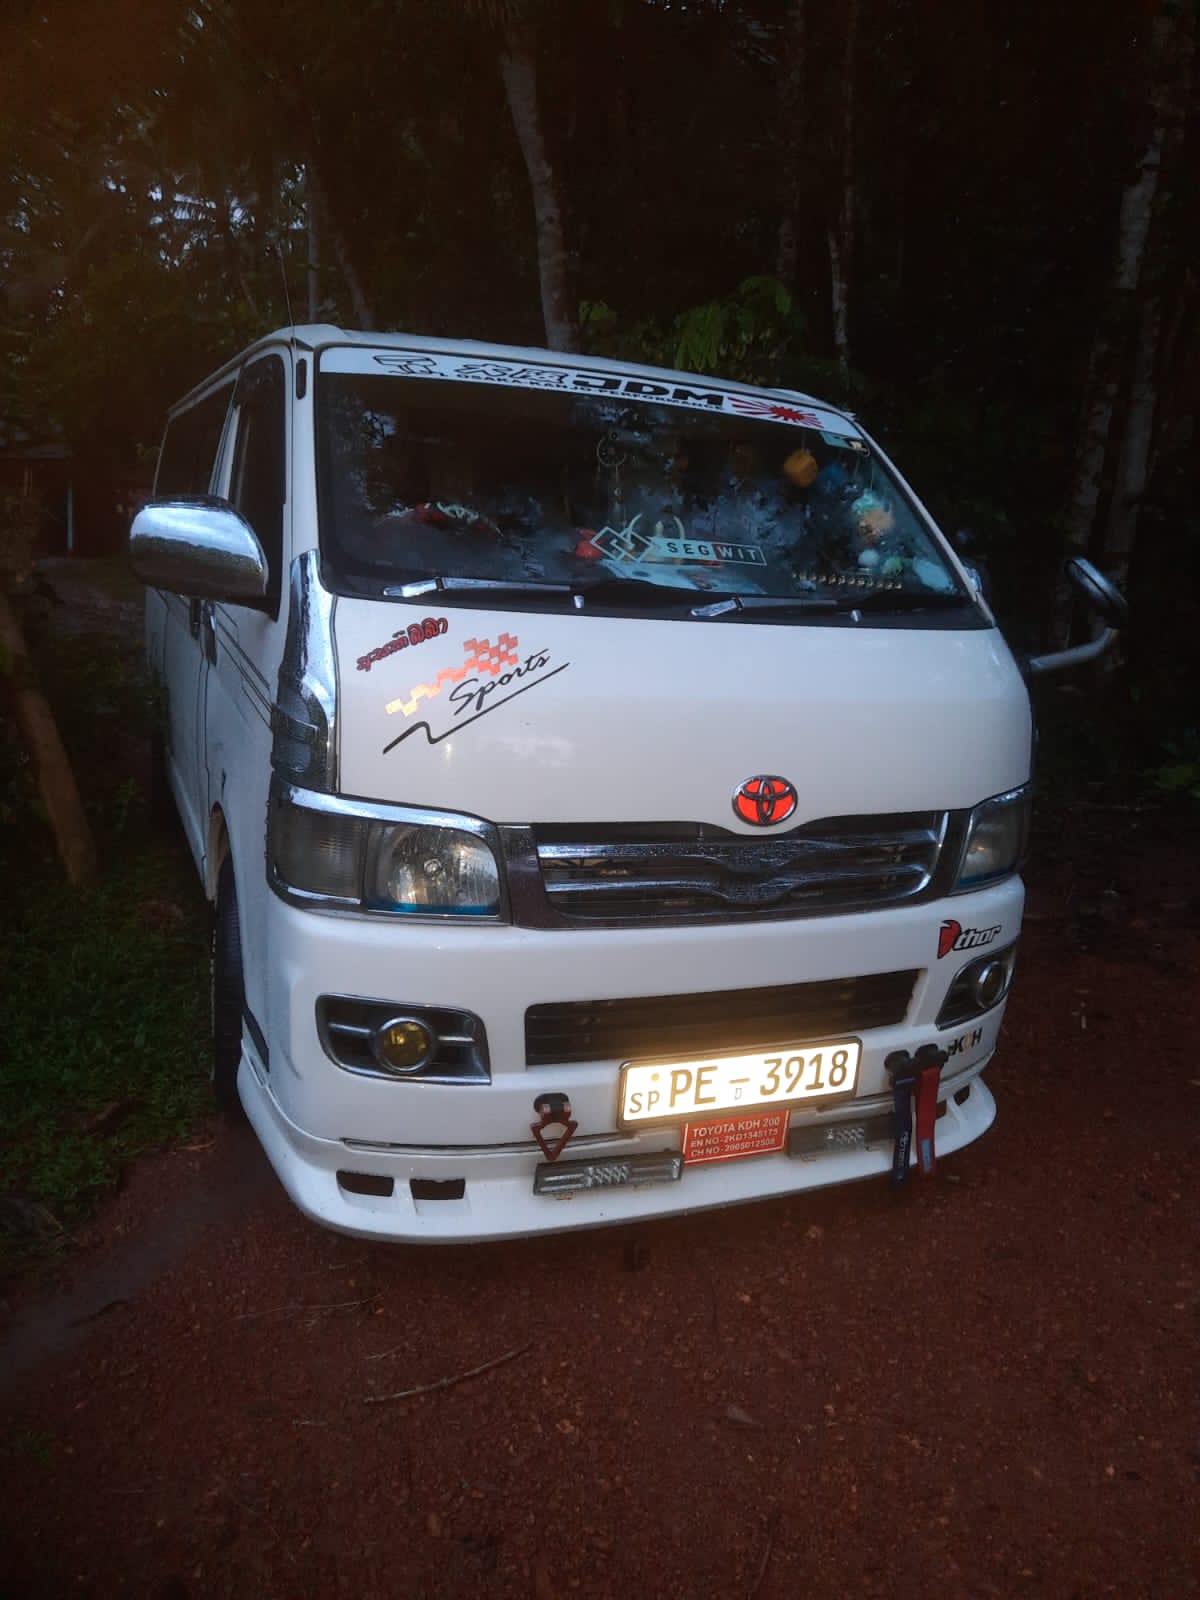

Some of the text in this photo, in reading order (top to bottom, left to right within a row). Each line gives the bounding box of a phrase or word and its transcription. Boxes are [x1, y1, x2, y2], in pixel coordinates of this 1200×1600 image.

[572, 374, 725, 406] JDM
[449, 648, 550, 715] Sports
[953, 924, 1002, 951] thor
[669, 1065, 718, 1108] PE
[760, 1050, 849, 1096] 3918
[629, 1091, 660, 1114] SP
[693, 1117, 780, 1138] TOYOTA KDH 200
[691, 1139, 704, 1148] EN
[691, 1149, 704, 1158] CH
